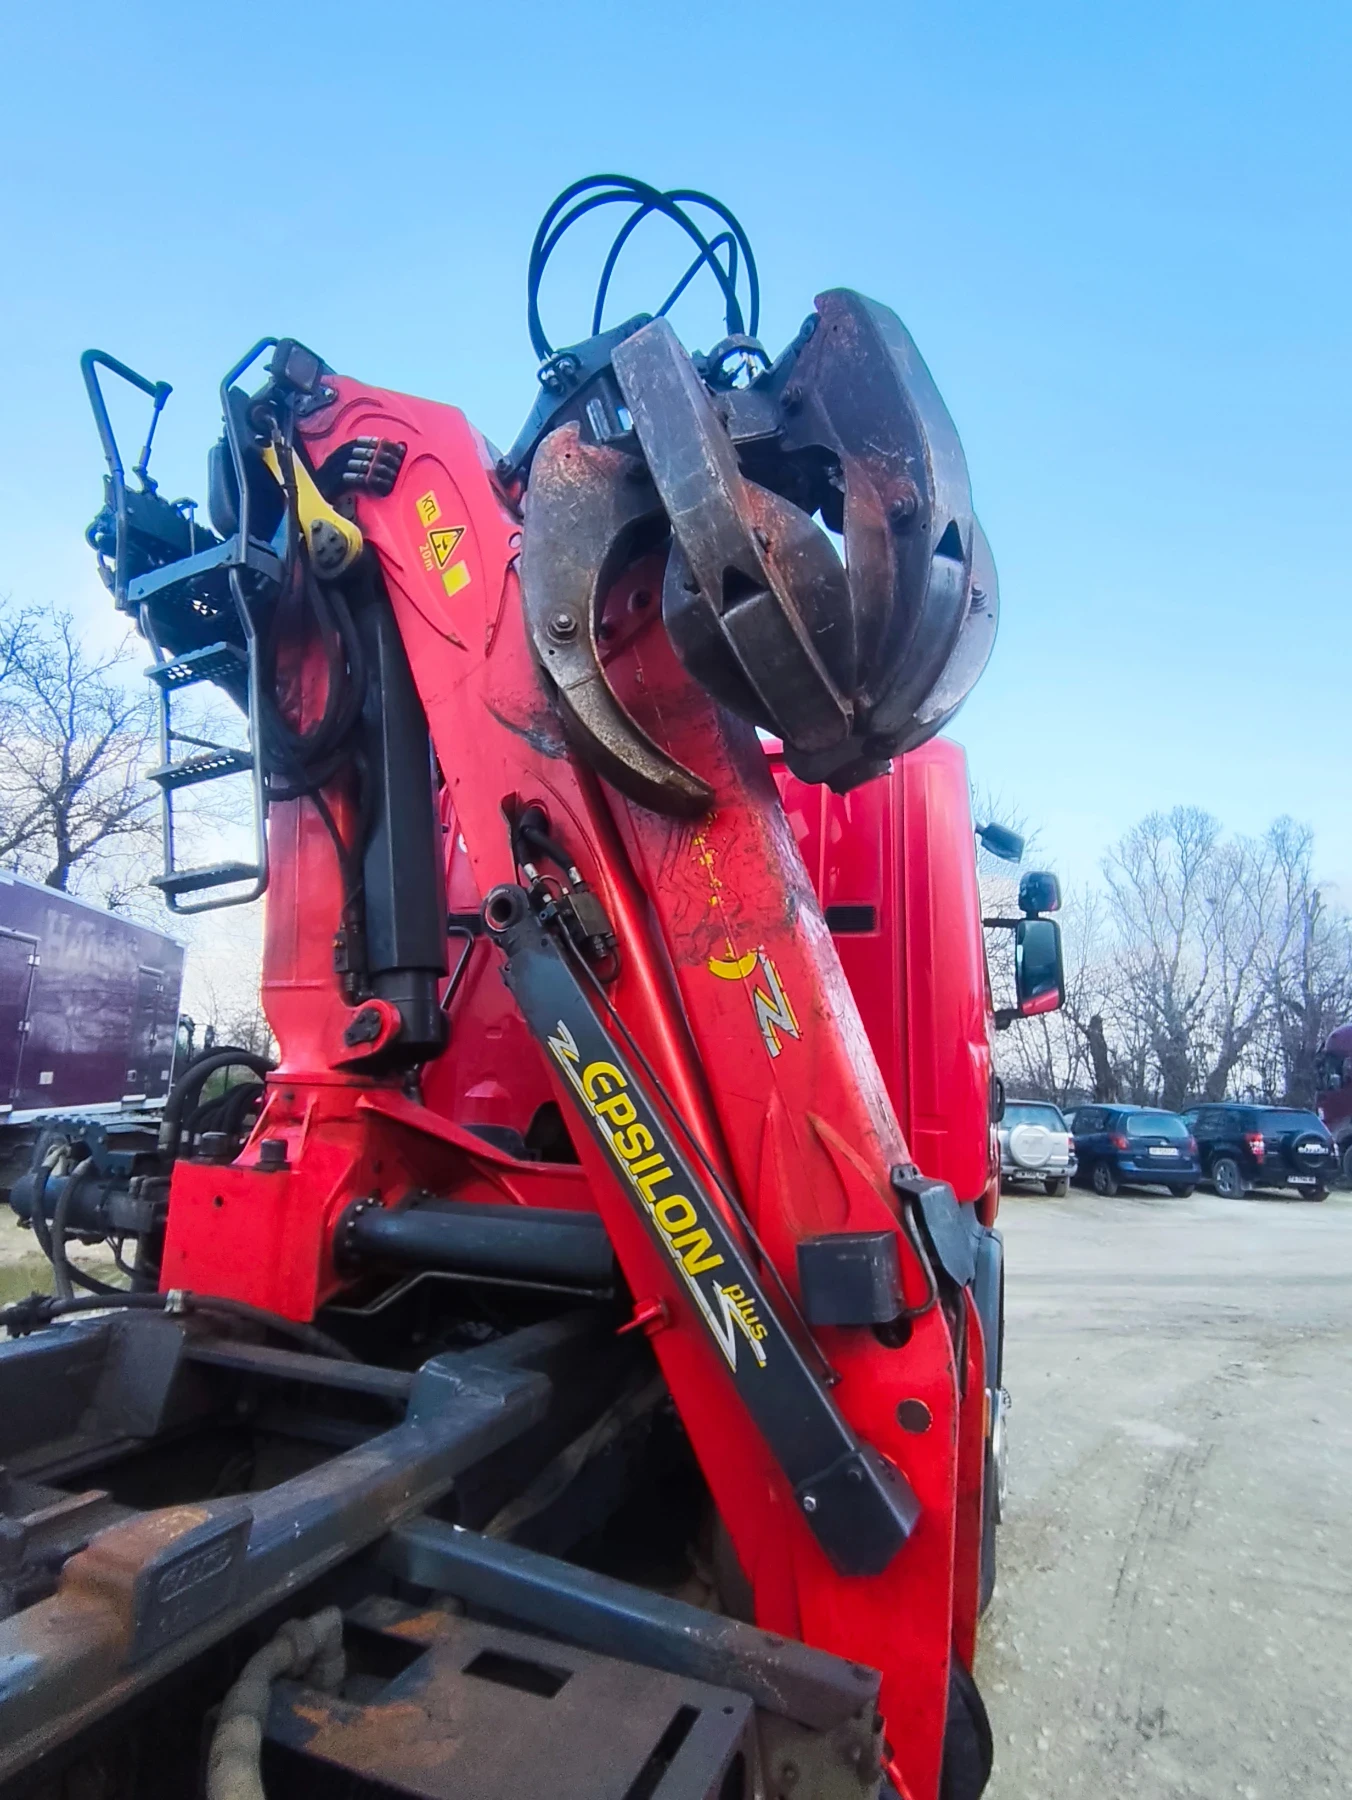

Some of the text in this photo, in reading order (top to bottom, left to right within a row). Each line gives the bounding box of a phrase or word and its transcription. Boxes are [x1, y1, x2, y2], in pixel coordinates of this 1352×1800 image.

[419, 543, 434, 571] 20m
[583, 1061, 768, 1341] EPSILON plus
